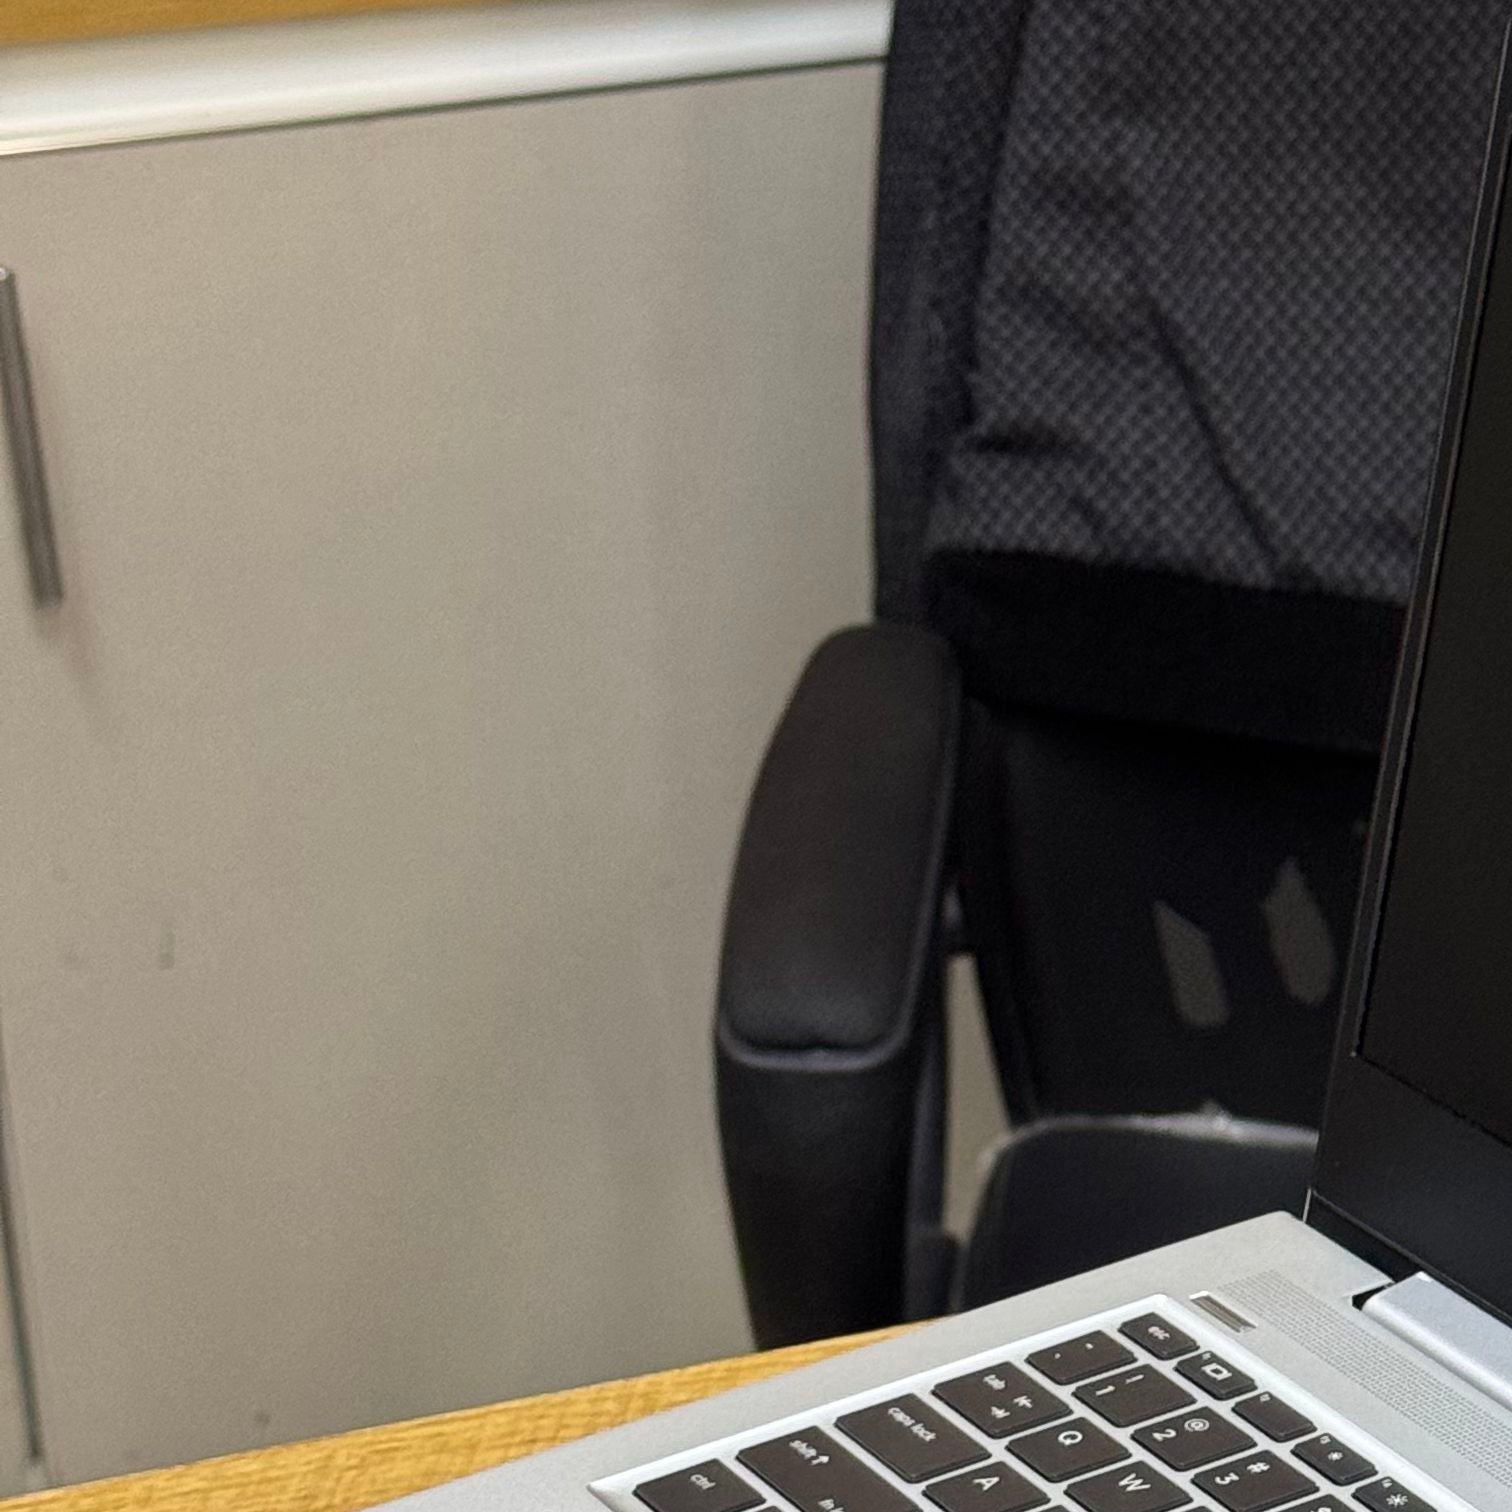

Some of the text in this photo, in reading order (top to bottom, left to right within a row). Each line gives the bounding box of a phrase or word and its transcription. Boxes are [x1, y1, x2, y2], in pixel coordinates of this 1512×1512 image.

[1095, 1385, 1116, 1396] 1
[1183, 1418, 1210, 1433] @
[1057, 1430, 1083, 1447] Q
[1152, 1428, 1177, 1442] 2
[1246, 1462, 1270, 1474] #
[972, 1476, 1000, 1492] A
[1118, 1473, 1152, 1492] W
[1214, 1472, 1240, 1485] 3
